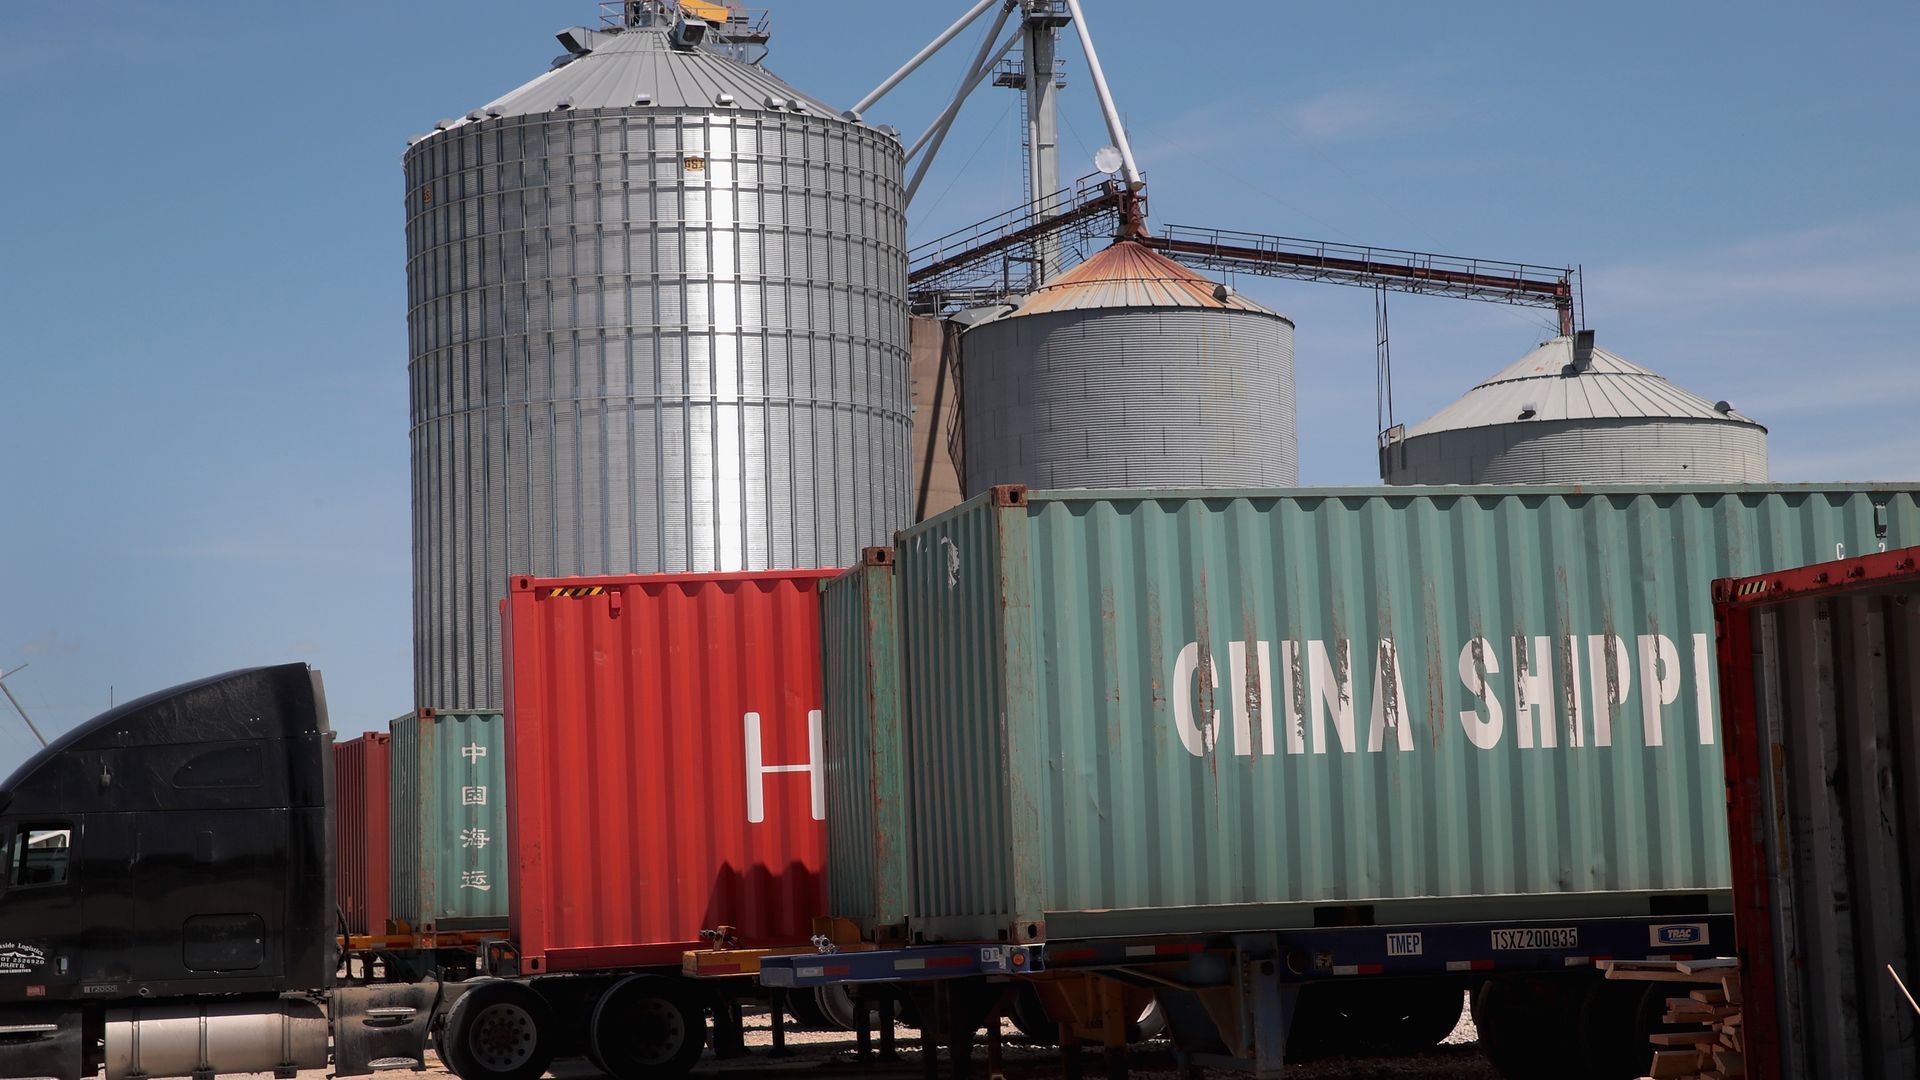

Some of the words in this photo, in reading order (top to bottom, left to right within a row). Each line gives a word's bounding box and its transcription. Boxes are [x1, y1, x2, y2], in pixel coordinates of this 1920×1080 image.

[1173, 637, 1415, 757] CHINA
[744, 709, 826, 823] H
[460, 742, 491, 891] 中国海运
[1388, 934, 1420, 953] TMEP
[1493, 929, 1577, 950] TSXZ200935
[1667, 928, 1692, 938] TRAC
[18, 943, 44, 956] Logistics
